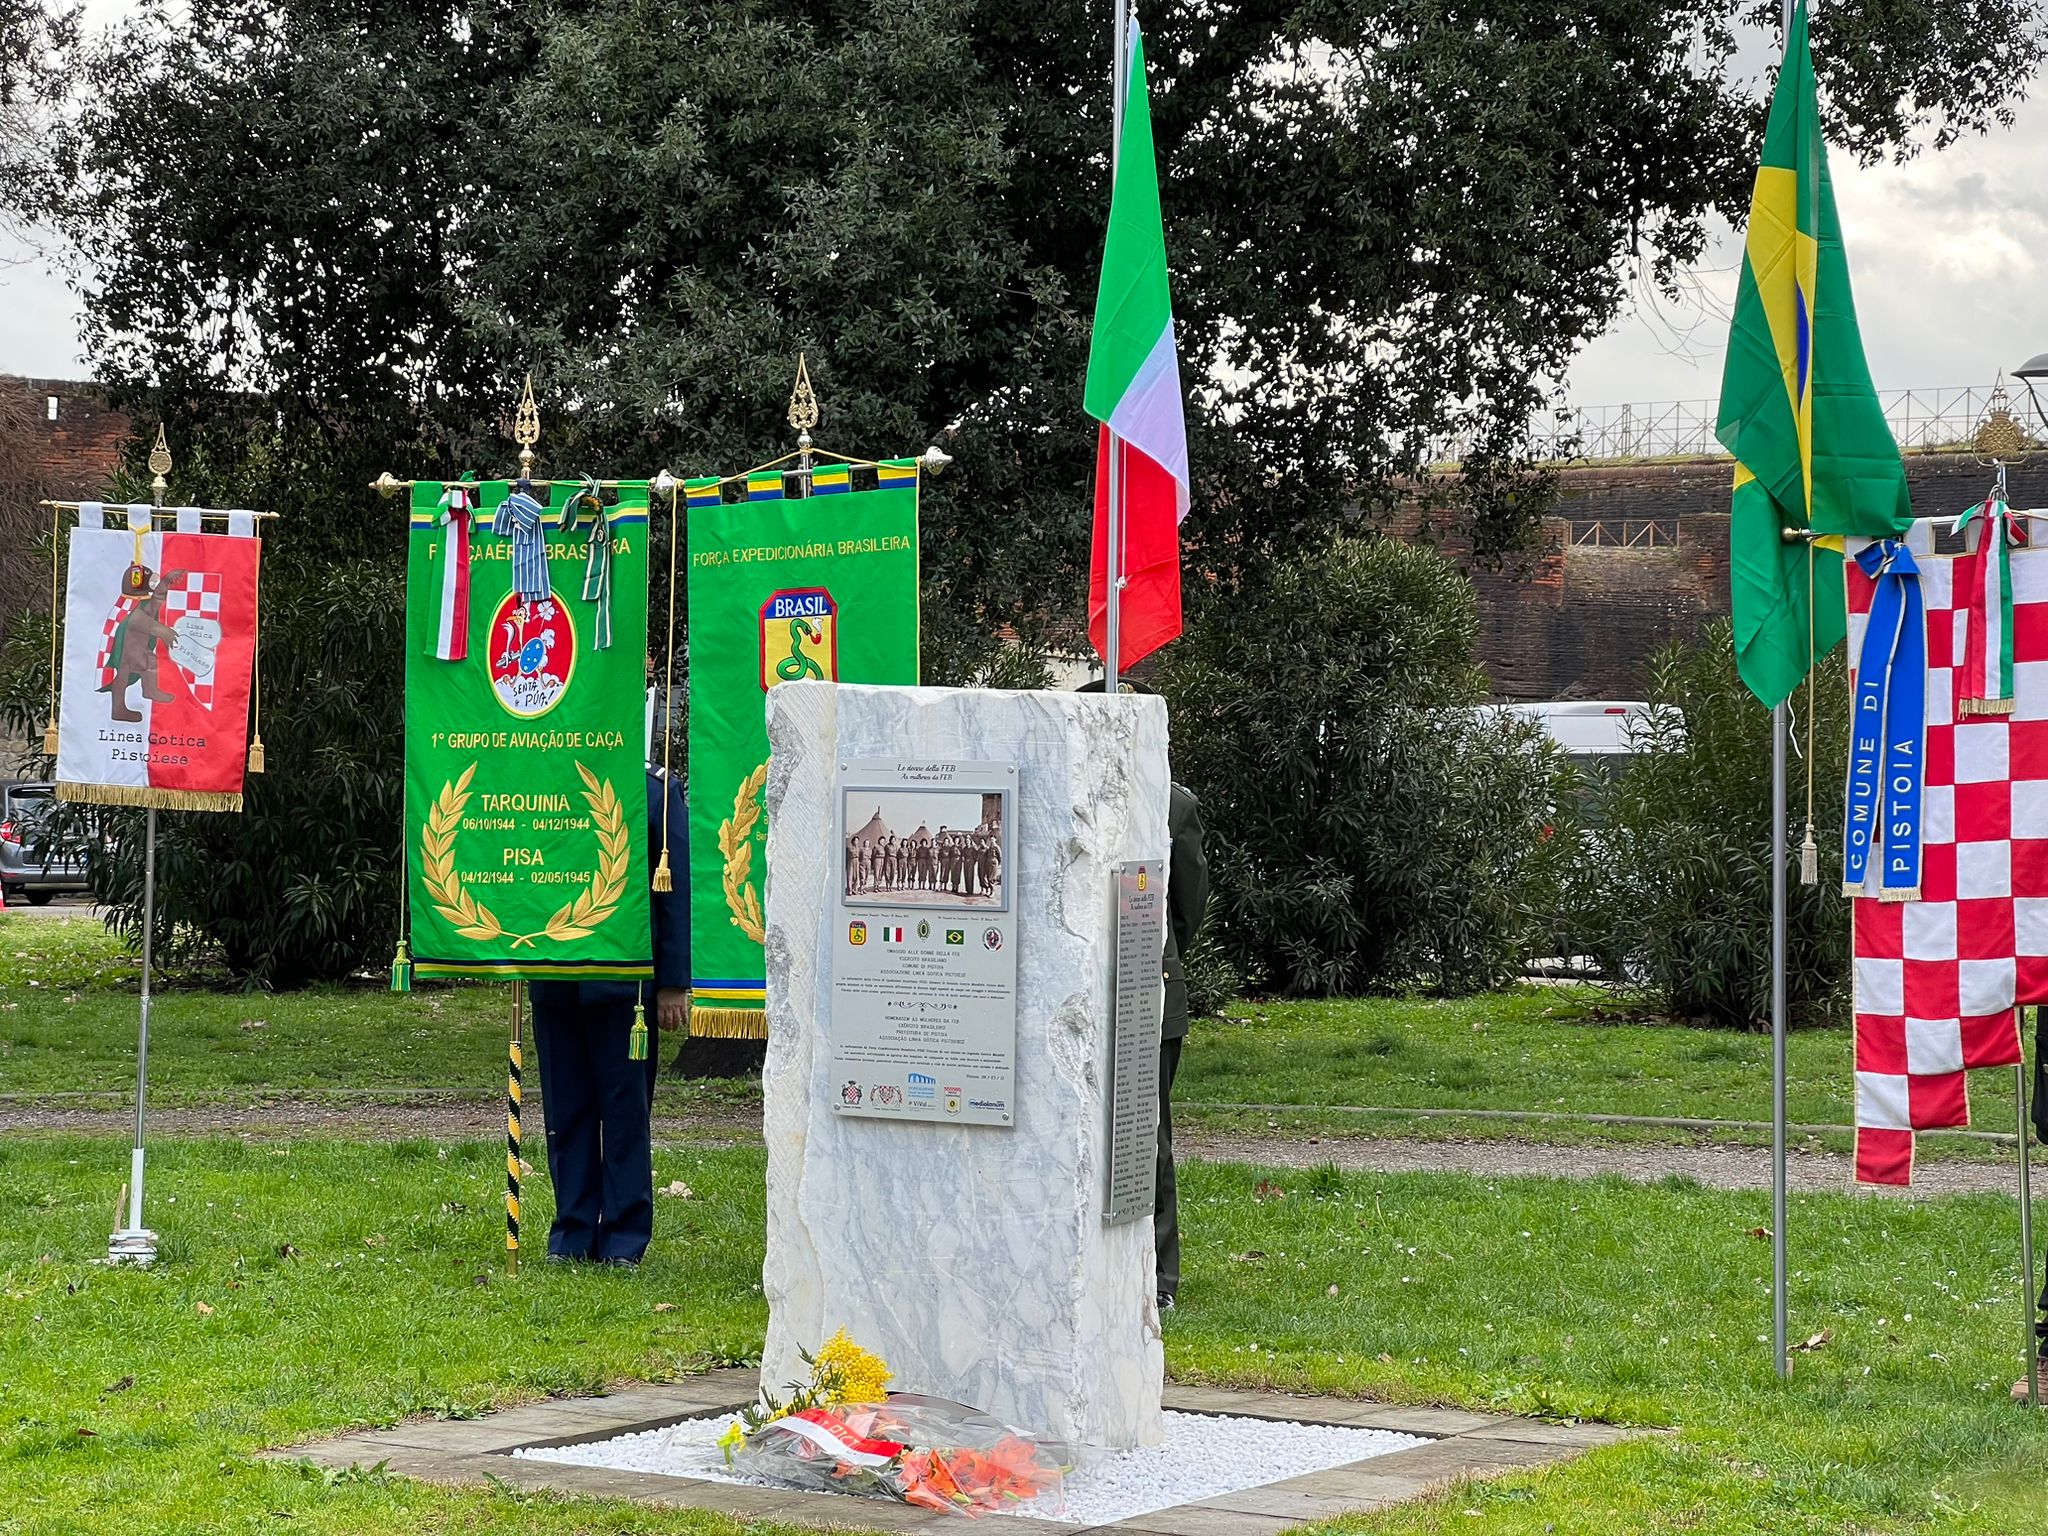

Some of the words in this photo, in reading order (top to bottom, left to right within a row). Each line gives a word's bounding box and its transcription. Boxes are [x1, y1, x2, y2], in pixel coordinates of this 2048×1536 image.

[693, 551, 730, 567] FORÇA
[732, 540, 834, 562] EXPEDICIONÁRIA
[838, 536, 910, 556] BRASILEIRA
[775, 596, 828, 618] BRASIL
[513, 682, 538, 697] SENTA
[98, 729, 142, 743] Linea
[148, 732, 206, 748] Gotica
[448, 732, 490, 748] GRUPO
[492, 732, 507, 748] DE
[509, 730, 564, 752] AVIAÇÃO
[566, 732, 582, 747] DE
[586, 731, 624, 751] CAÇA
[111, 748, 188, 765] Pistoiese
[1851, 737, 1875, 869] COMUNE
[1863, 682, 1879, 712] DI
[481, 794, 570, 812] TARQUINIA
[1892, 740, 1914, 872] PISTOIA
[462, 818, 516, 830] 06/10/1944
[532, 818, 590, 830] 04/12/1944
[503, 848, 544, 866] PISA
[461, 872, 514, 884] 04/12/1944
[531, 872, 590, 884] 02/05/1945
